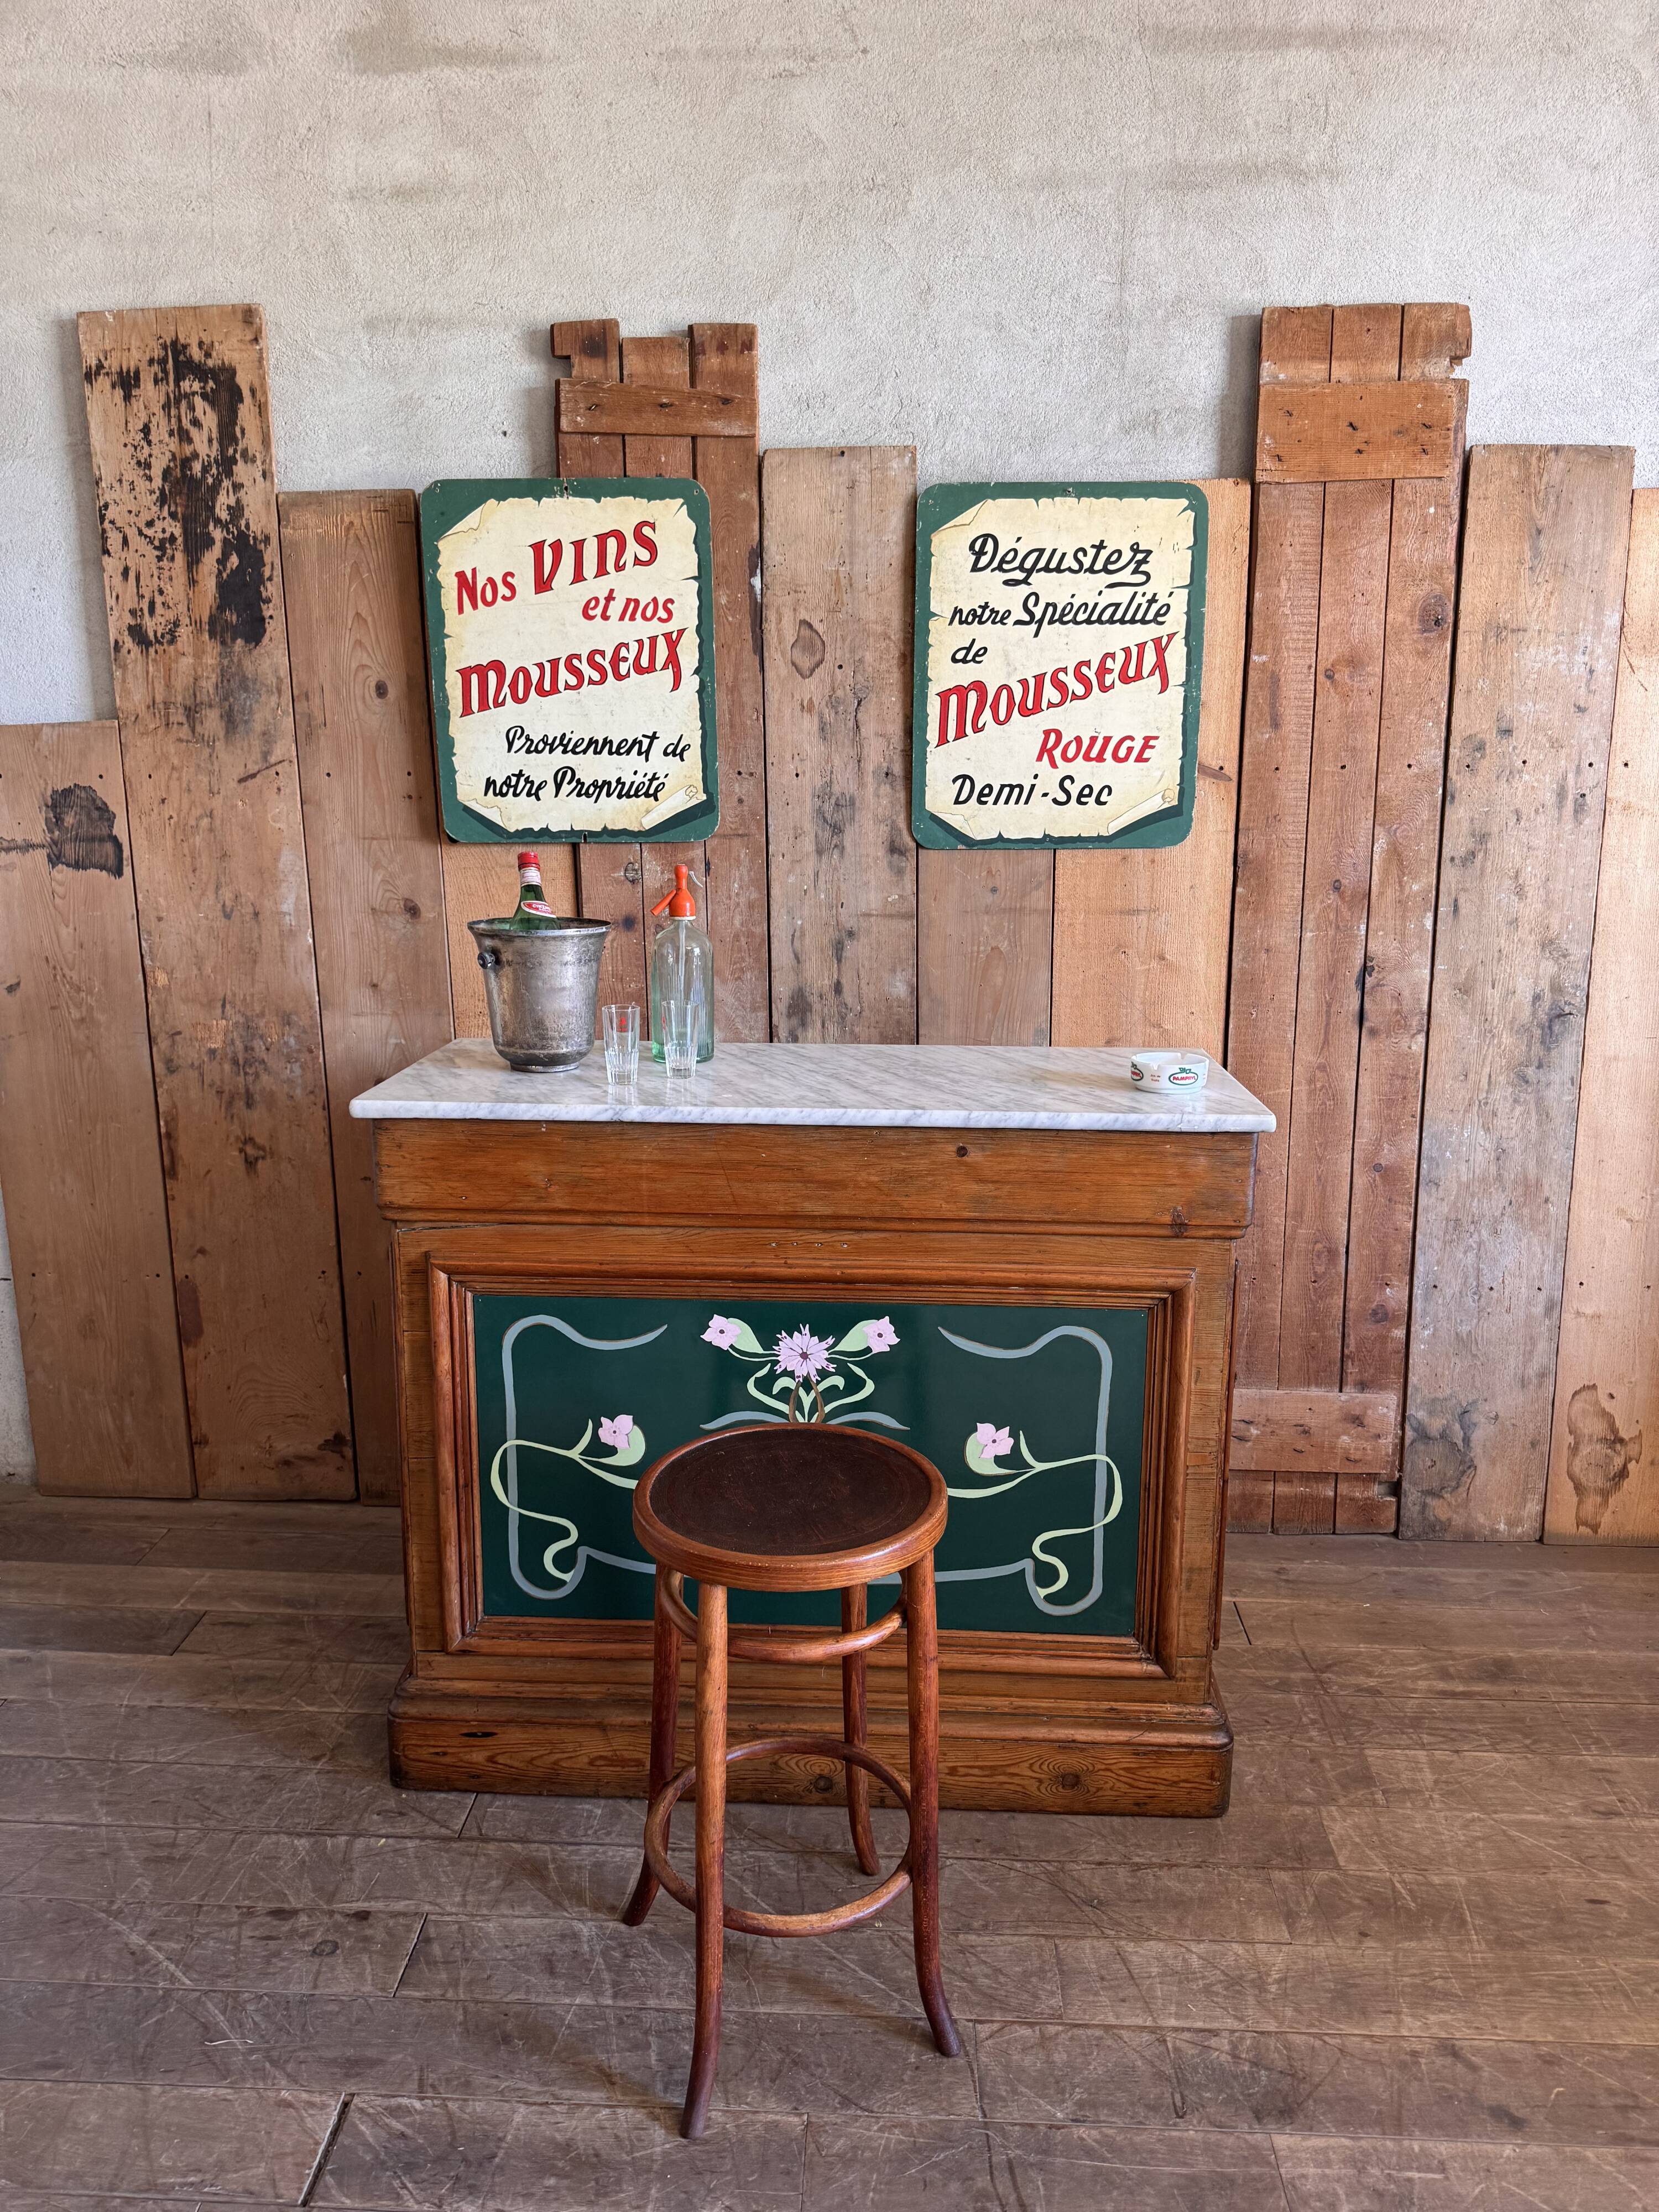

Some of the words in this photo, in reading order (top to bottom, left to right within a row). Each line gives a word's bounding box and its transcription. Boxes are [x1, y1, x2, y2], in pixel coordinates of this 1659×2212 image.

[968, 533, 1154, 588] Dégustez
[455, 567, 517, 615] Nos
[582, 588, 616, 621] et
[618, 597, 675, 624] nos
[948, 601, 1011, 626] notre
[1013, 588, 1174, 638] Spécialité
[950, 638, 988, 664] de
[505, 725, 658, 763] Proviennent
[662, 734, 691, 763] de
[483, 769, 547, 802] notre
[553, 766, 670, 804] Propriété
